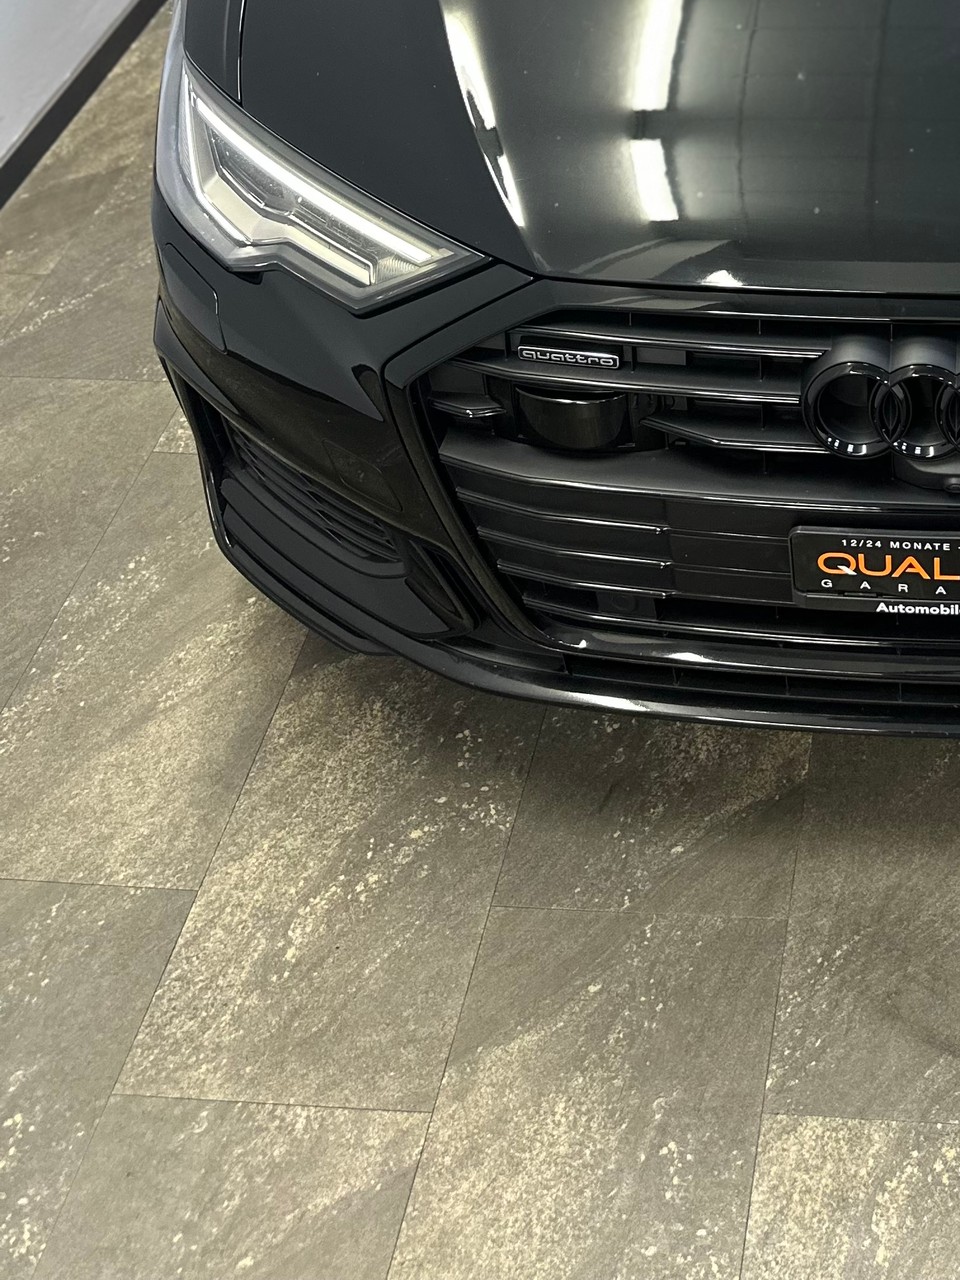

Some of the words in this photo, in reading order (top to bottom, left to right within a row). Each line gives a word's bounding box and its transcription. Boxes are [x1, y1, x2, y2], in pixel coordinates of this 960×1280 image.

[521, 349, 615, 367] quattro
[841, 538, 883, 548] 12/24
[889, 540, 951, 551] MONATE
